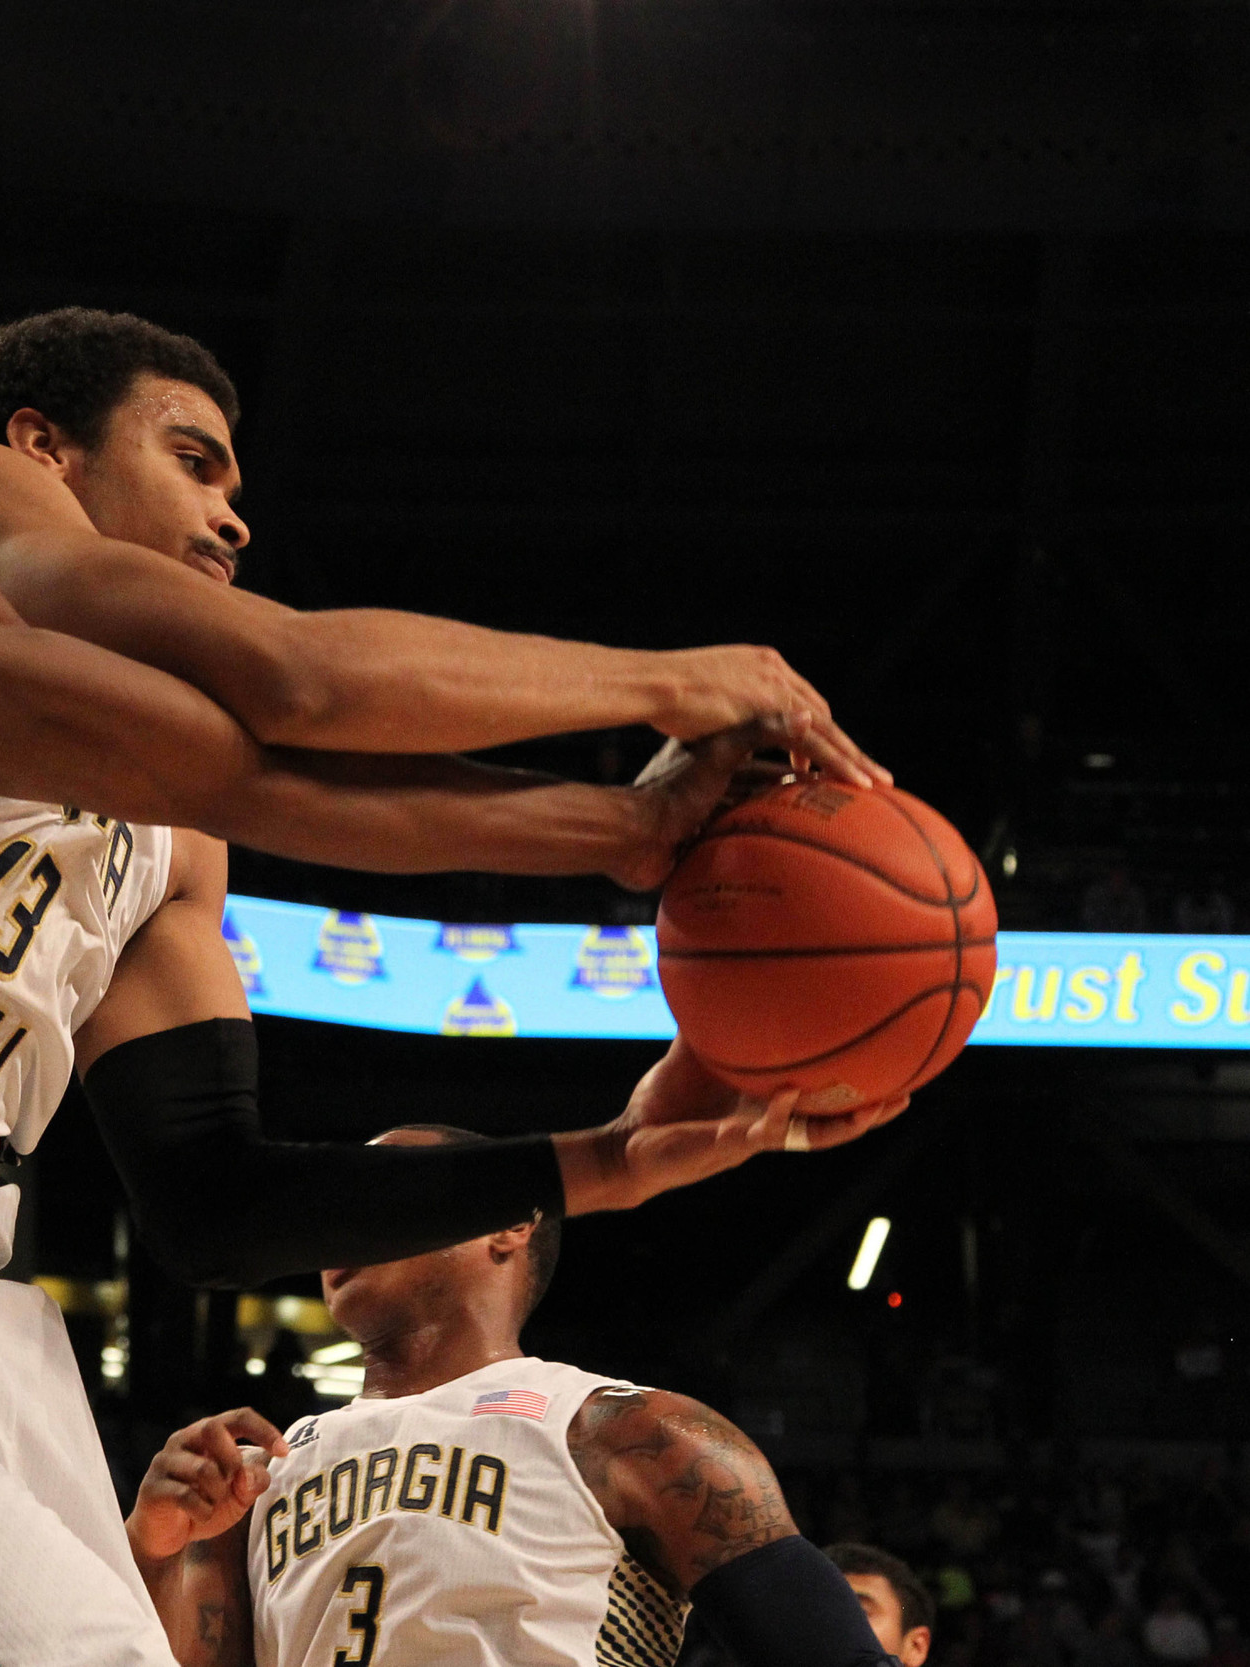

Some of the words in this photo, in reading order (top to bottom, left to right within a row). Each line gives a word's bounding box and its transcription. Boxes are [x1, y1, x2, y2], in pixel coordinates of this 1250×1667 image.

[979, 952, 1145, 1022] rust
[264, 1442, 510, 1587] GEORGIA
[331, 1561, 387, 1667] 3
